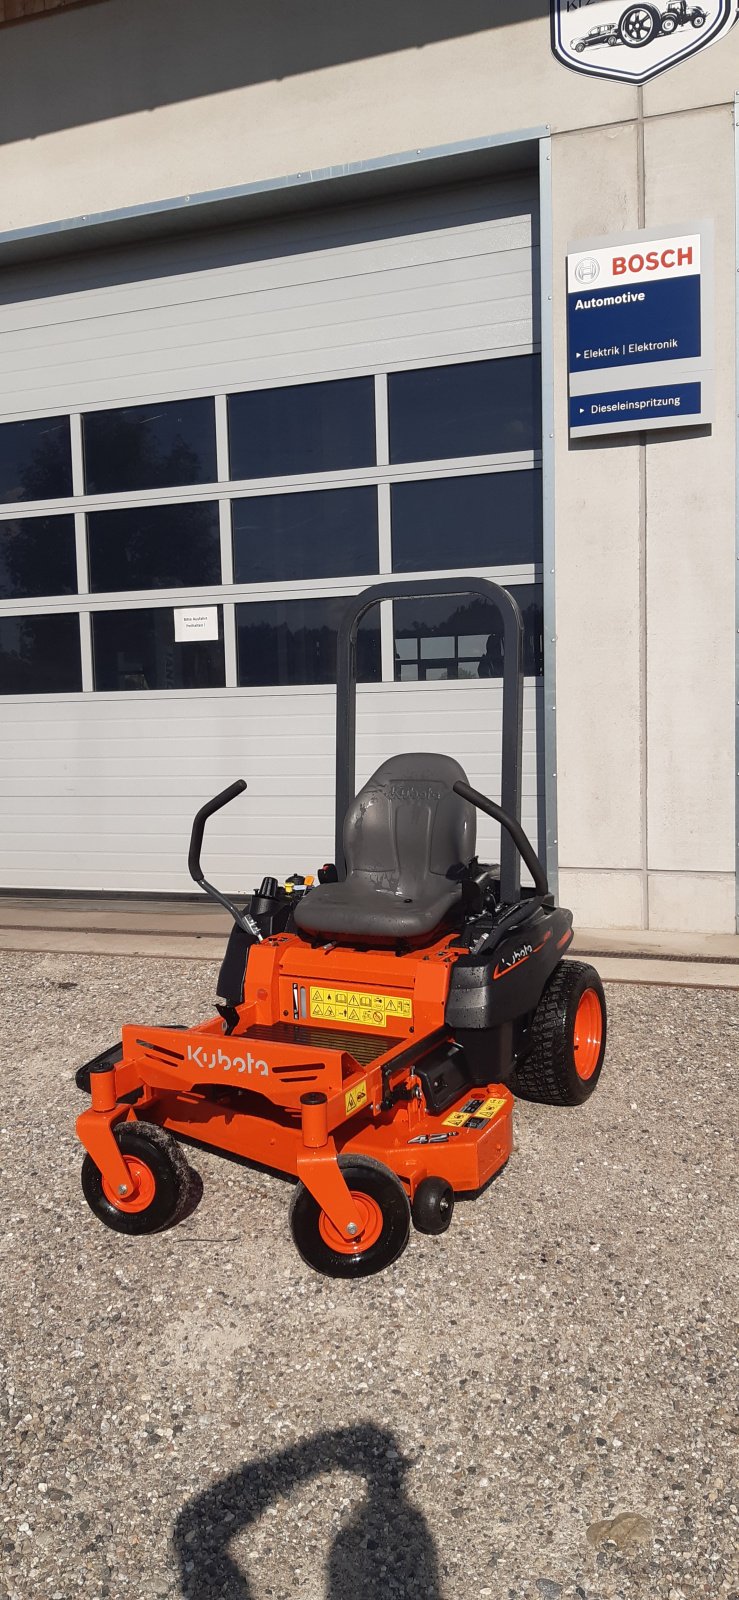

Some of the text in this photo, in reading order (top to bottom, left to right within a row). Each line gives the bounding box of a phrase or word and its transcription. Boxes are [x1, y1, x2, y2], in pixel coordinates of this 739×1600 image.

[612, 246, 693, 276] BOSCH
[575, 292, 646, 310] Automotive
[583, 345, 620, 359] Elektrik
[628, 338, 678, 353] Elektronik
[591, 397, 681, 414] Dieseleinspritzung
[187, 1045, 269, 1076] Kubota
